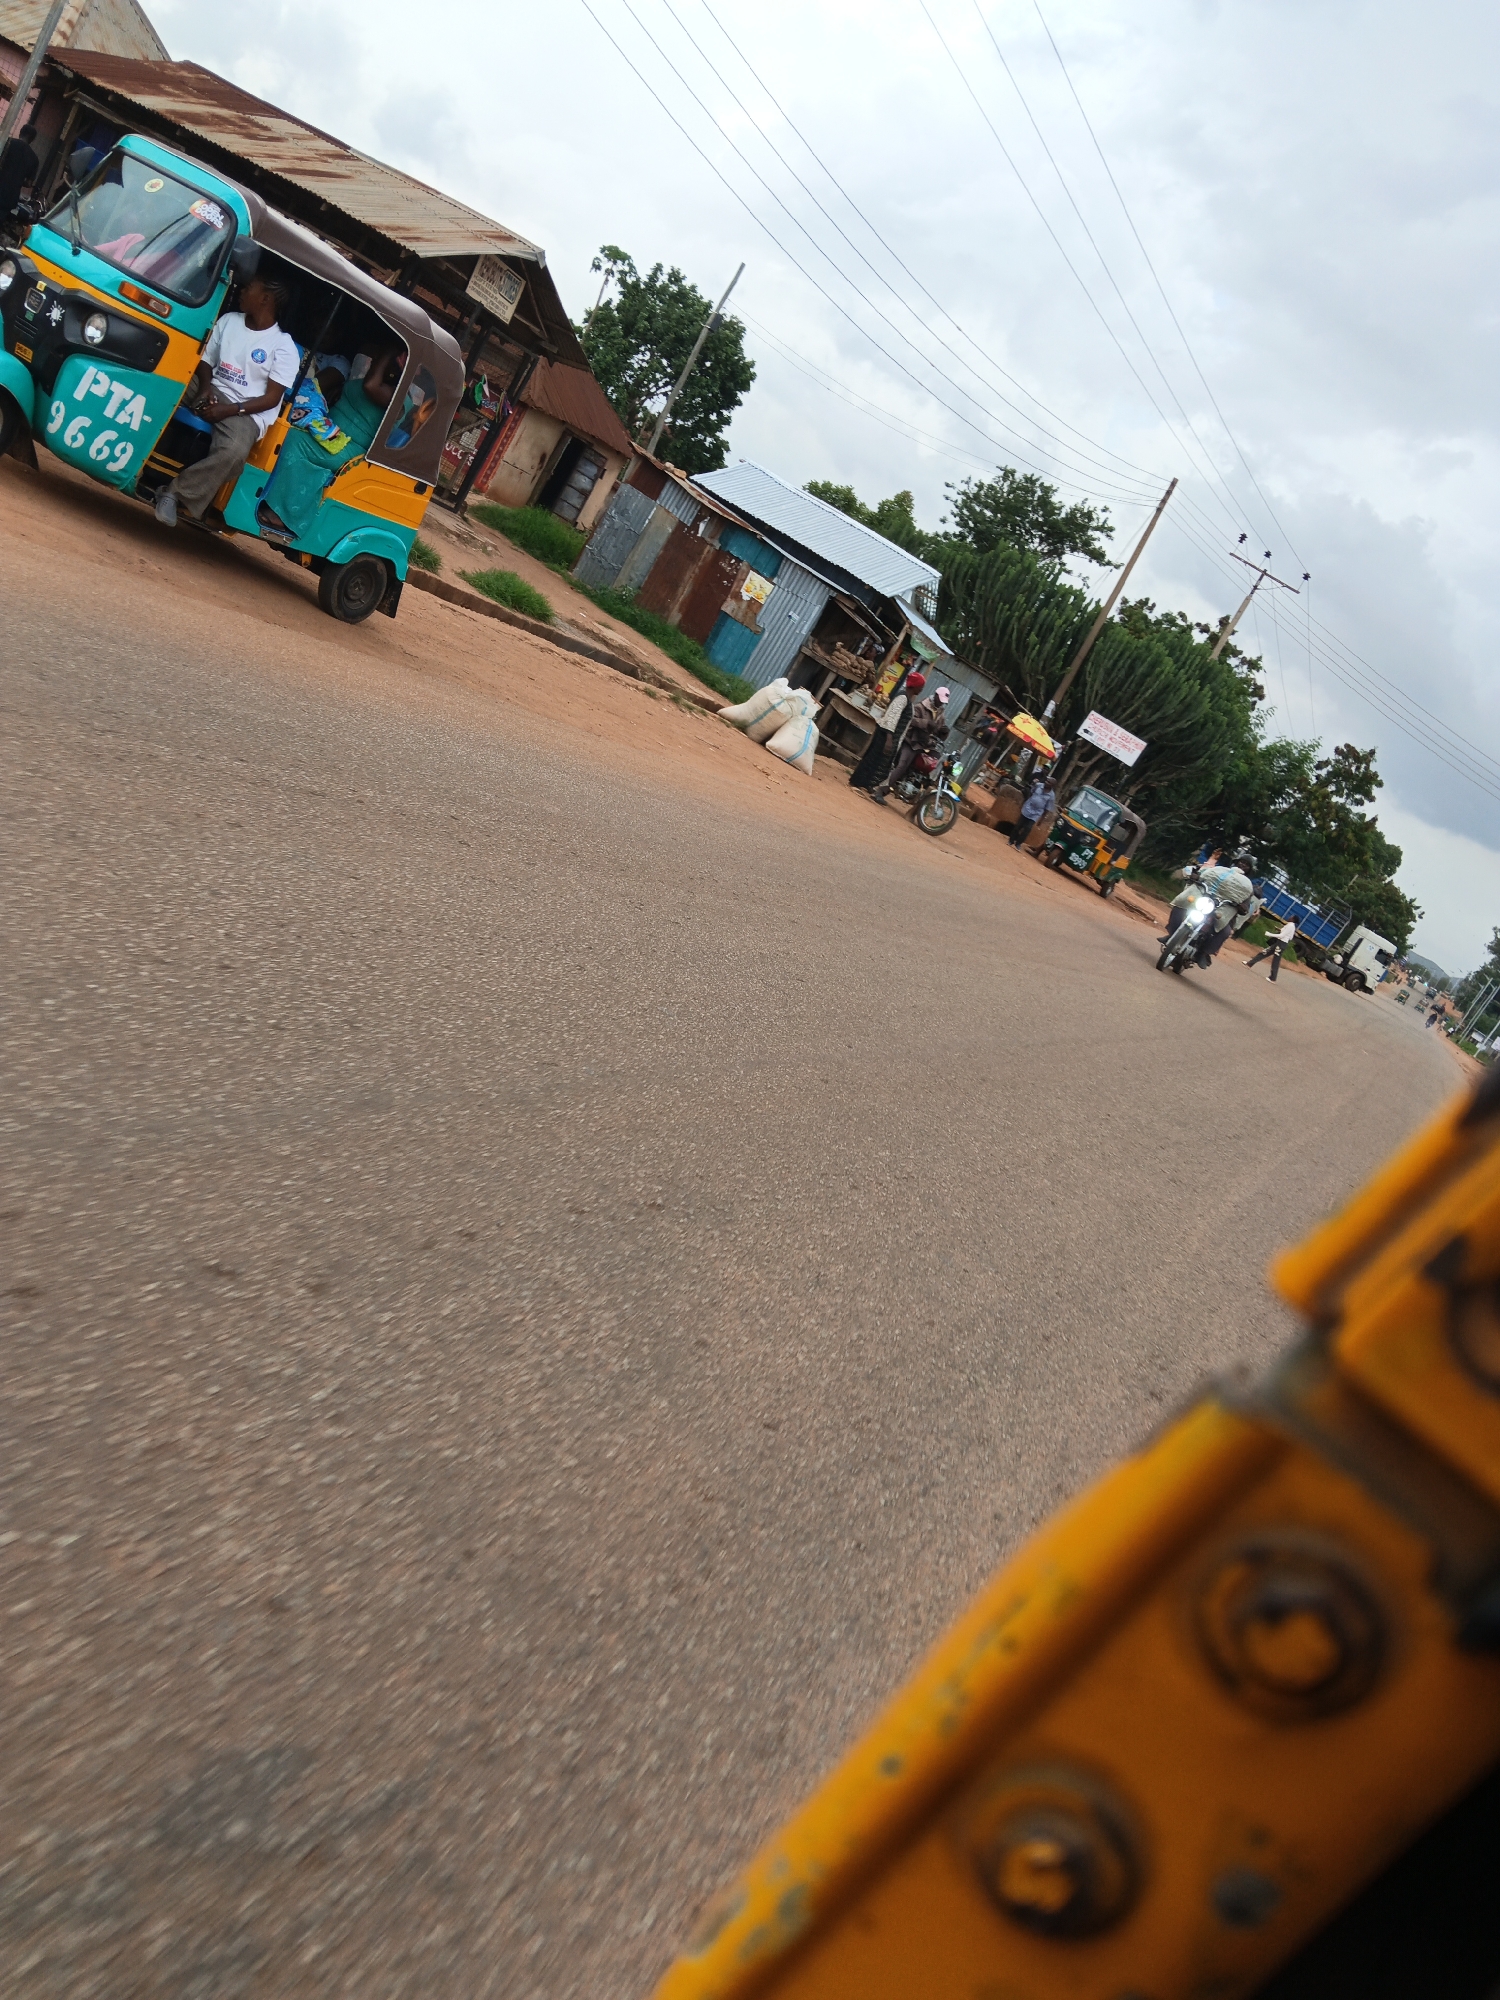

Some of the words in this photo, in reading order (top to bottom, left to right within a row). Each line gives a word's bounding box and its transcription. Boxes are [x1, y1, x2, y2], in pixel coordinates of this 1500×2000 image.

[195, 207, 223, 228] DOORS
[200, 203, 224, 220] OPEN
[46, 401, 134, 472] 9669
